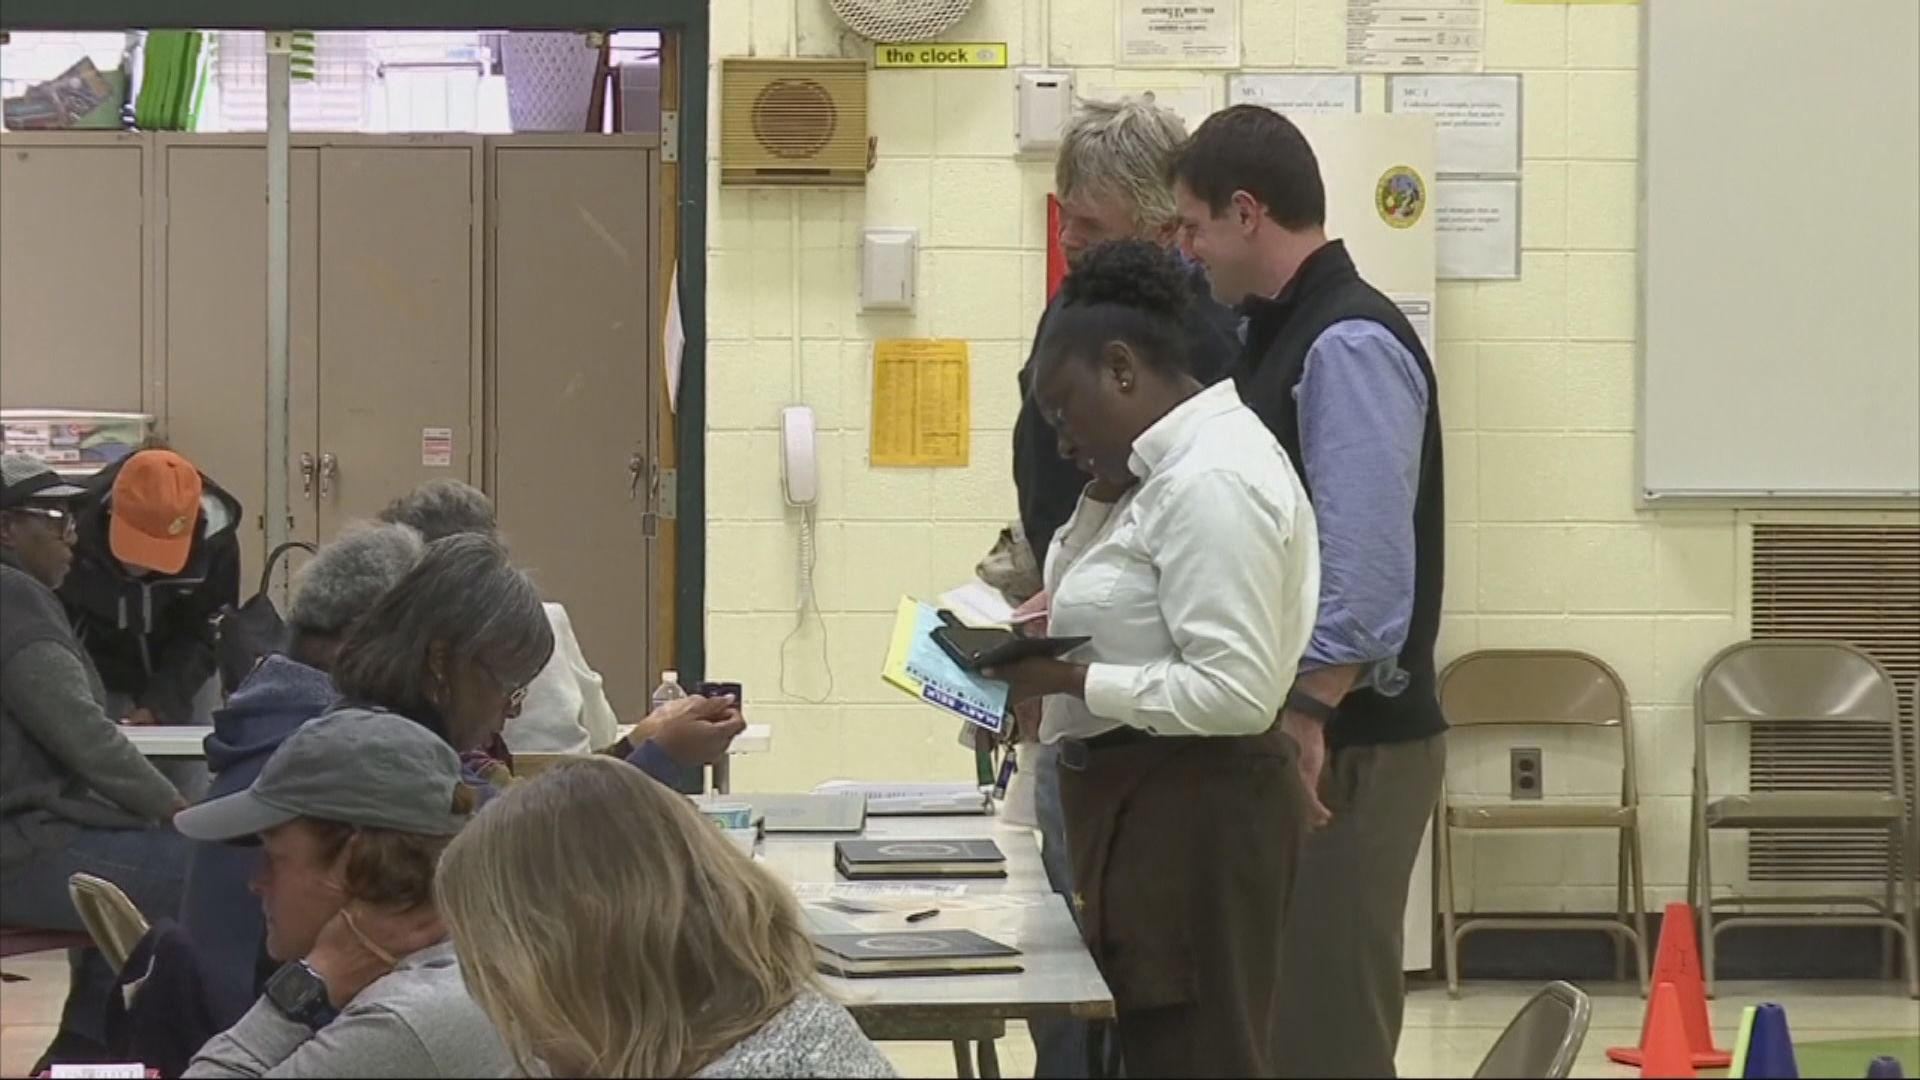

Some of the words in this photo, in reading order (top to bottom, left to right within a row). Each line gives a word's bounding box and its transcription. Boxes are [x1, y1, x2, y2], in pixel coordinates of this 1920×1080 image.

[886, 48, 914, 63] the
[920, 48, 968, 63] clock
[960, 704, 998, 727] MARY
